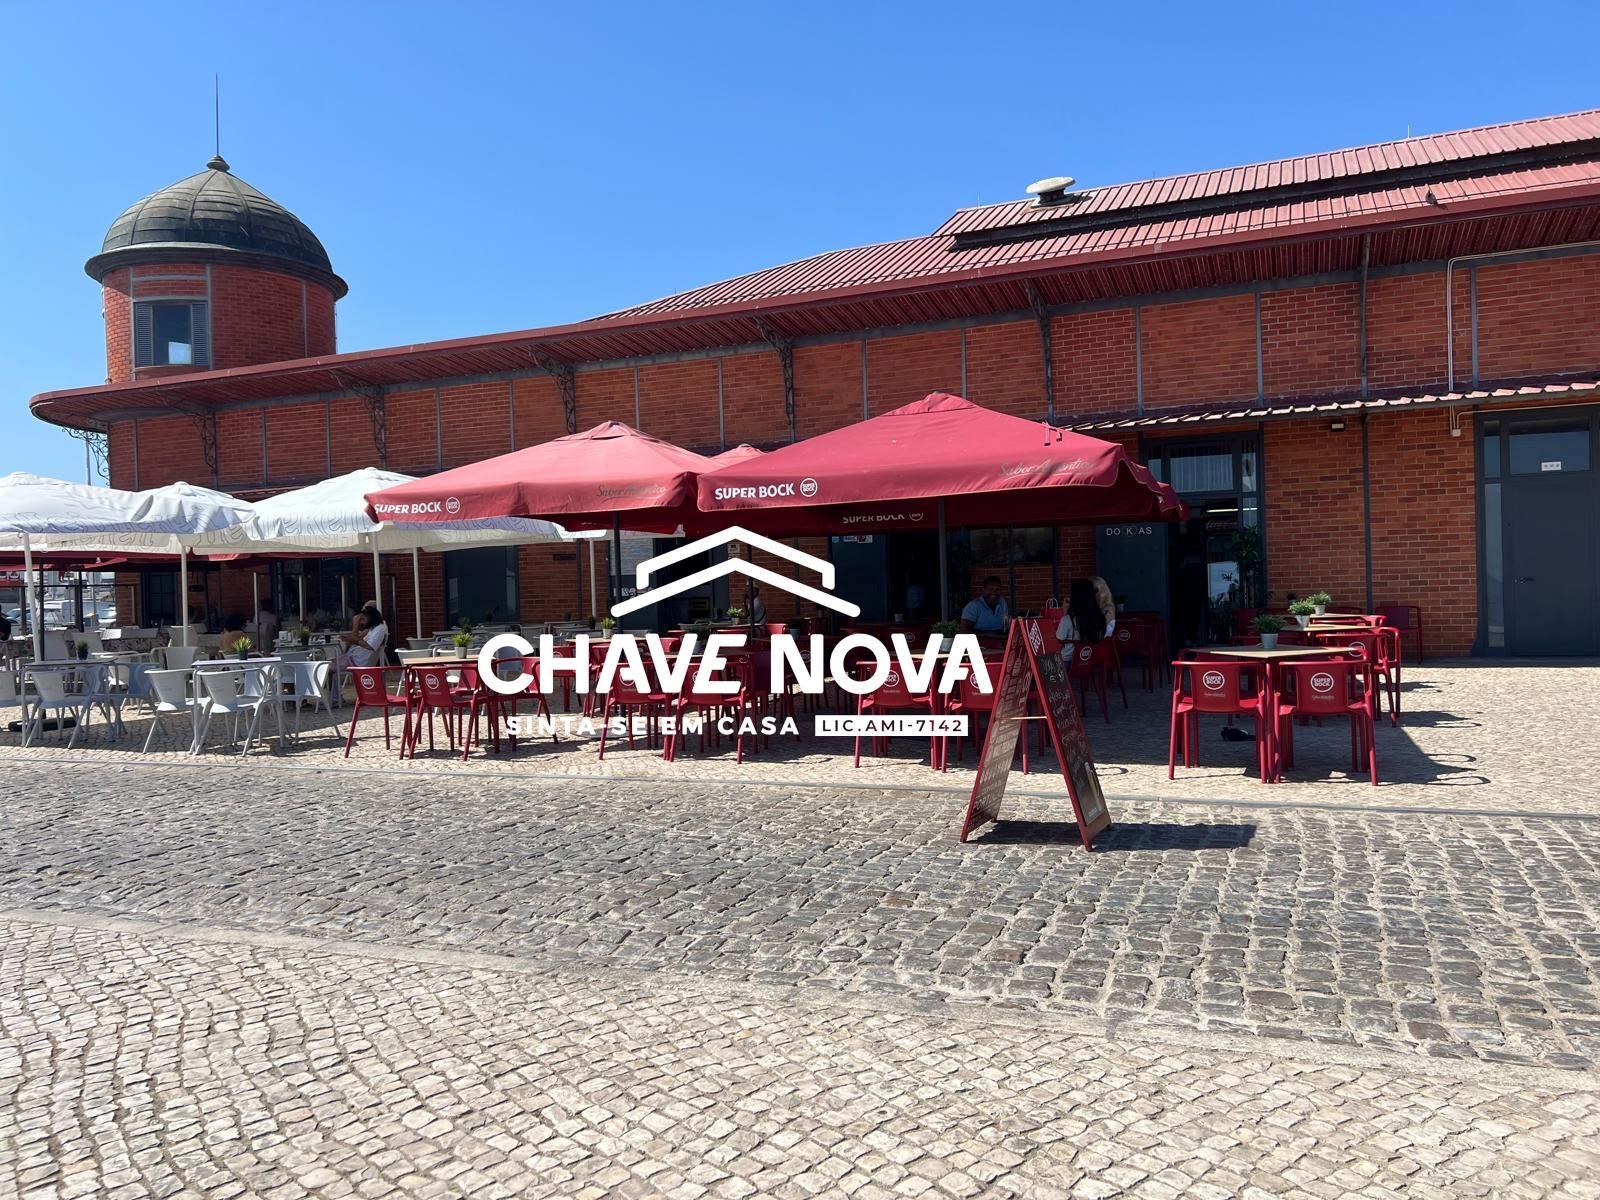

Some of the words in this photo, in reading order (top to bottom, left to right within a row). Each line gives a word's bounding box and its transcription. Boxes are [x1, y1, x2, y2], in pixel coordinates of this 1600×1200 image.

[715, 486, 756, 500] SUPER
[759, 483, 795, 498] BOCK
[374, 503, 409, 514] SUPER
[411, 501, 442, 514] BOCK
